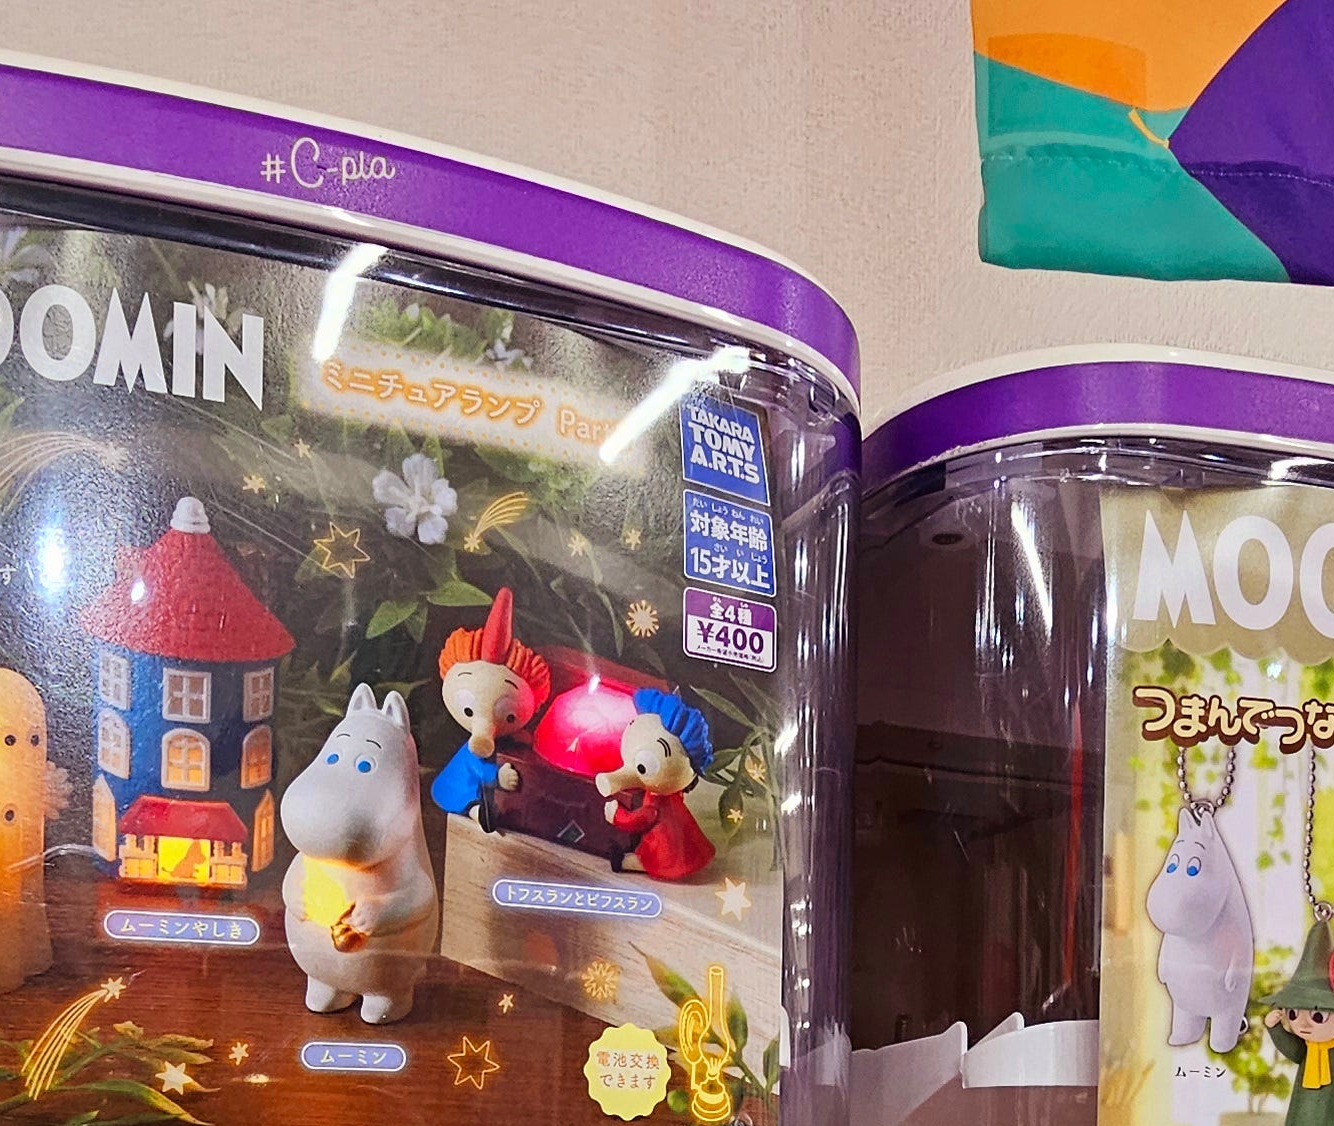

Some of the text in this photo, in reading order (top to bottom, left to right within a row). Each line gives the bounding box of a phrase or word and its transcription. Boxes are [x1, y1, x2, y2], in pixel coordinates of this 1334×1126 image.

[261, 137, 396, 189] #C-pla
[322, 360, 545, 426] ミニチュアランプ
[687, 406, 756, 445] TAKARA
[688, 422, 756, 463] TOMY
[690, 511, 768, 551] 対象年齢
[690, 547, 770, 589] 15才以上
[709, 600, 753, 627] 全4種
[696, 618, 765, 655] ¥400
[119, 917, 245, 939] ムーミンやしき
[320, 1049, 389, 1067] ムーミン
[595, 1050, 660, 1071] 電池交換
[1174, 1065, 1227, 1080] ムーミン
[599, 1072, 657, 1090] できます
